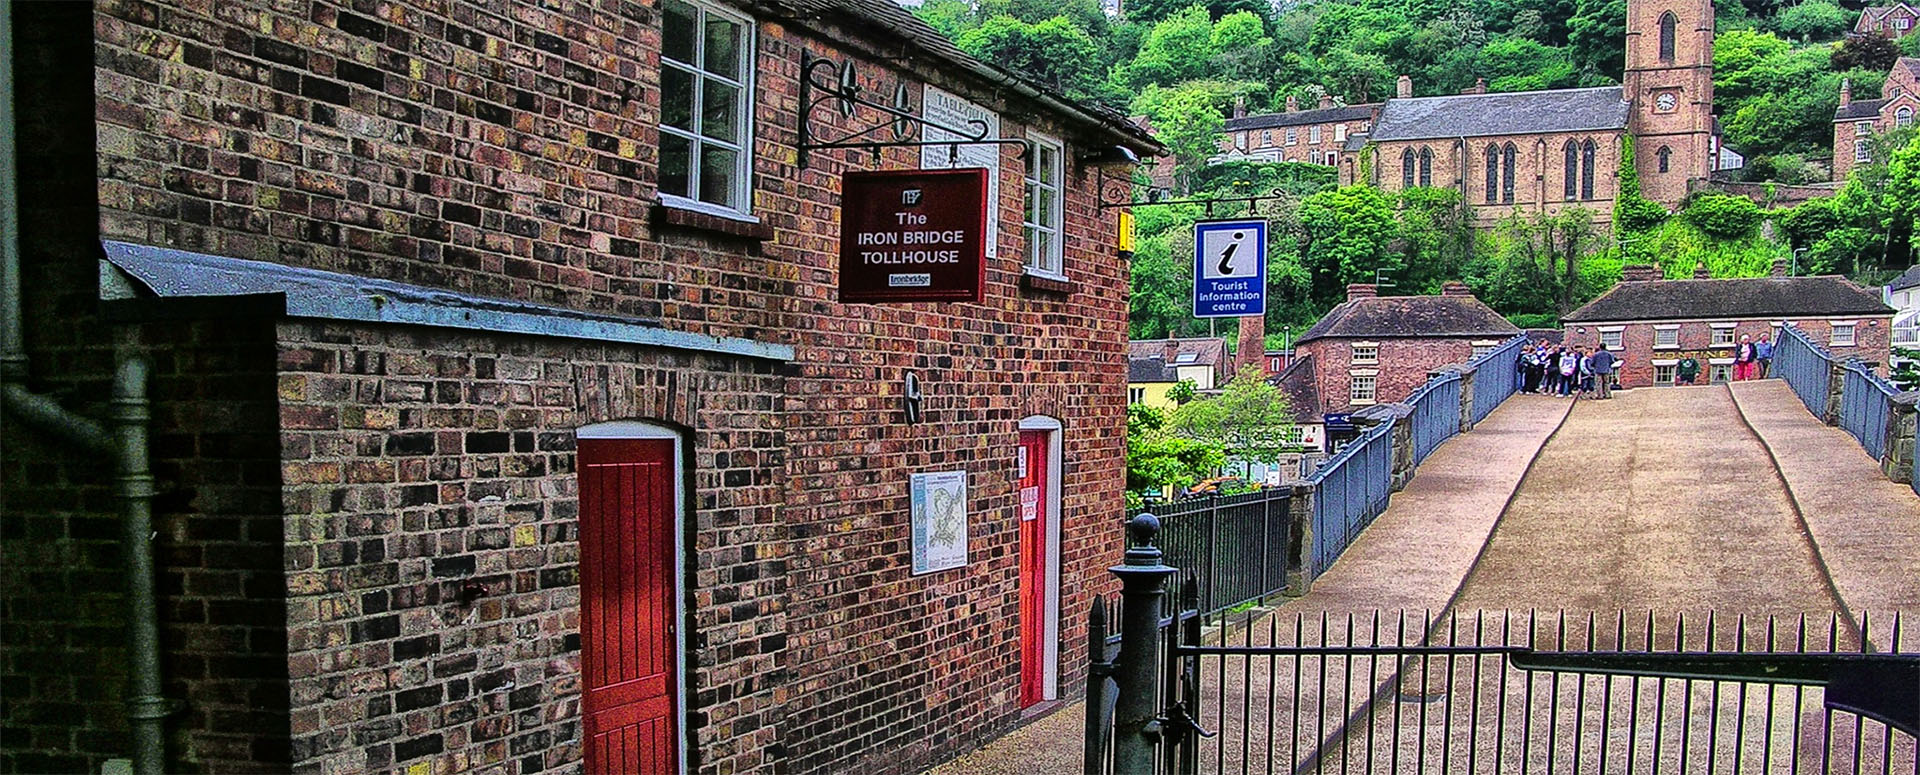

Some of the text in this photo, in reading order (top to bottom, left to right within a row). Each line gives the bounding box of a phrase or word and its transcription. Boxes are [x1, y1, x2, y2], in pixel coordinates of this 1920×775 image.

[895, 212, 927, 225] The
[858, 230, 964, 245] IRON BRIDGE
[861, 250, 960, 264] TOLLHOUSE
[1211, 281, 1248, 291] Tourist
[1199, 292, 1260, 301] information
[1212, 303, 1247, 311] centre
